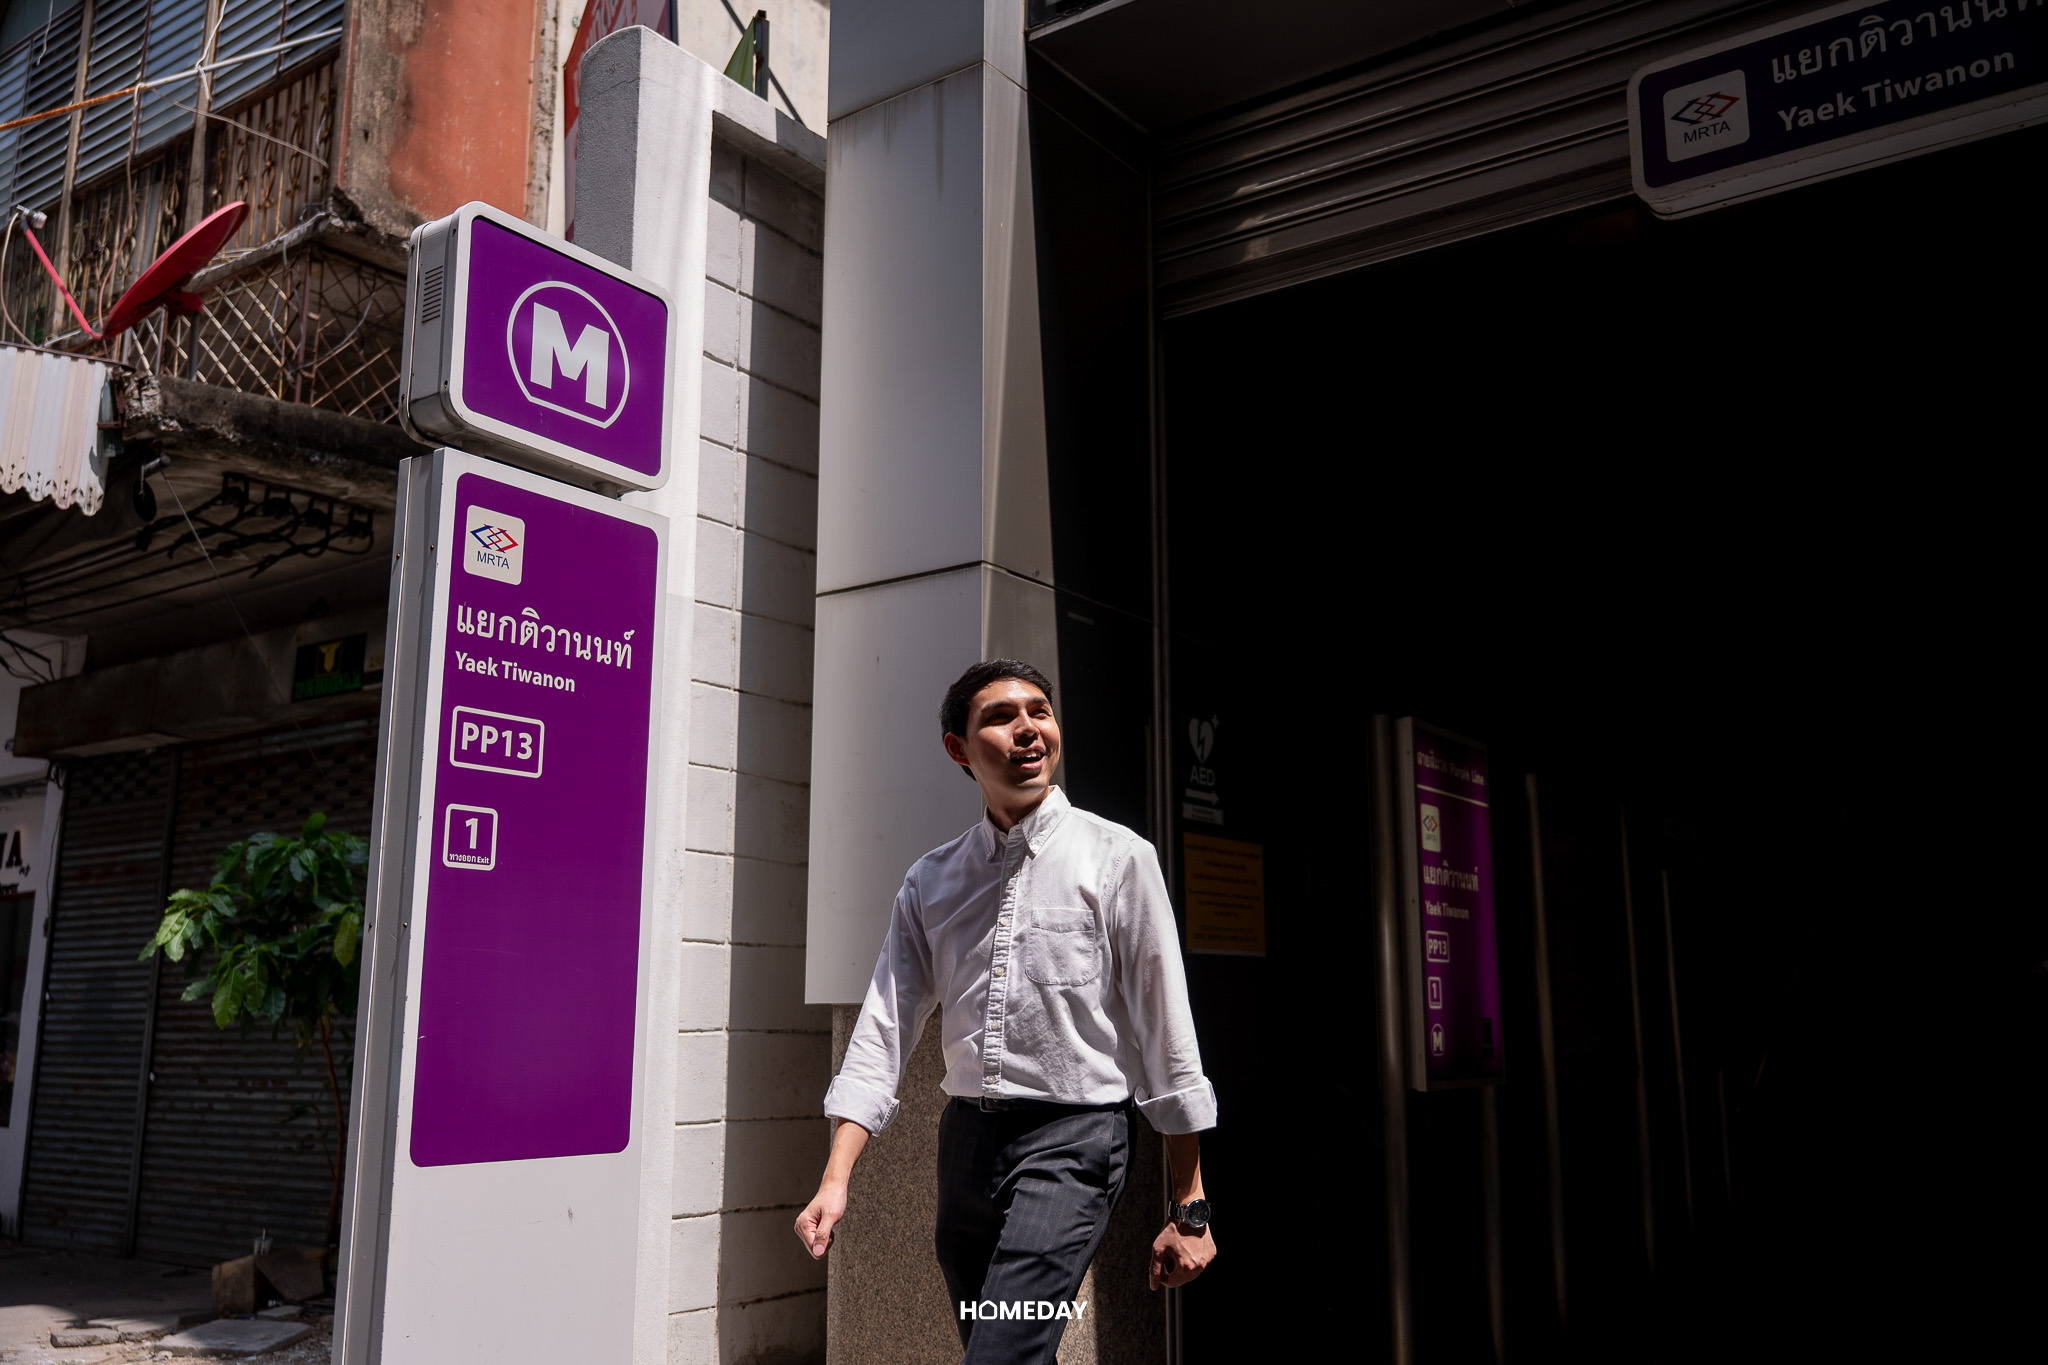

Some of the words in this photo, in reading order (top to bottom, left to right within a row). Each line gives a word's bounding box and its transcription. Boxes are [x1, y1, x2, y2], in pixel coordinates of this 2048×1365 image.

[1771, 0, 2044, 84] แยกติวานน
[1777, 92, 1856, 132] Yaek
[1861, 51, 2016, 109] Tiwanon
[1684, 120, 1731, 145] MRTA
[530, 301, 610, 410] M
[476, 550, 510, 570] MRTA
[456, 603, 635, 670] แยกติวานนท์
[455, 650, 498, 678] Yaek
[501, 660, 576, 693] Tiwanon
[461, 721, 533, 761] PP13
[1190, 764, 1216, 787] AED
[465, 817, 479, 849] 1
[449, 853, 476, 863] ทางออก
[477, 856, 490, 864] Exit
[1424, 899, 1442, 916] Yaek
[1442, 902, 1470, 920] Tiwanon
[1428, 939, 1447, 956] PP13
[1431, 982, 1438, 1000] 1
[1432, 1030, 1444, 1052] M
